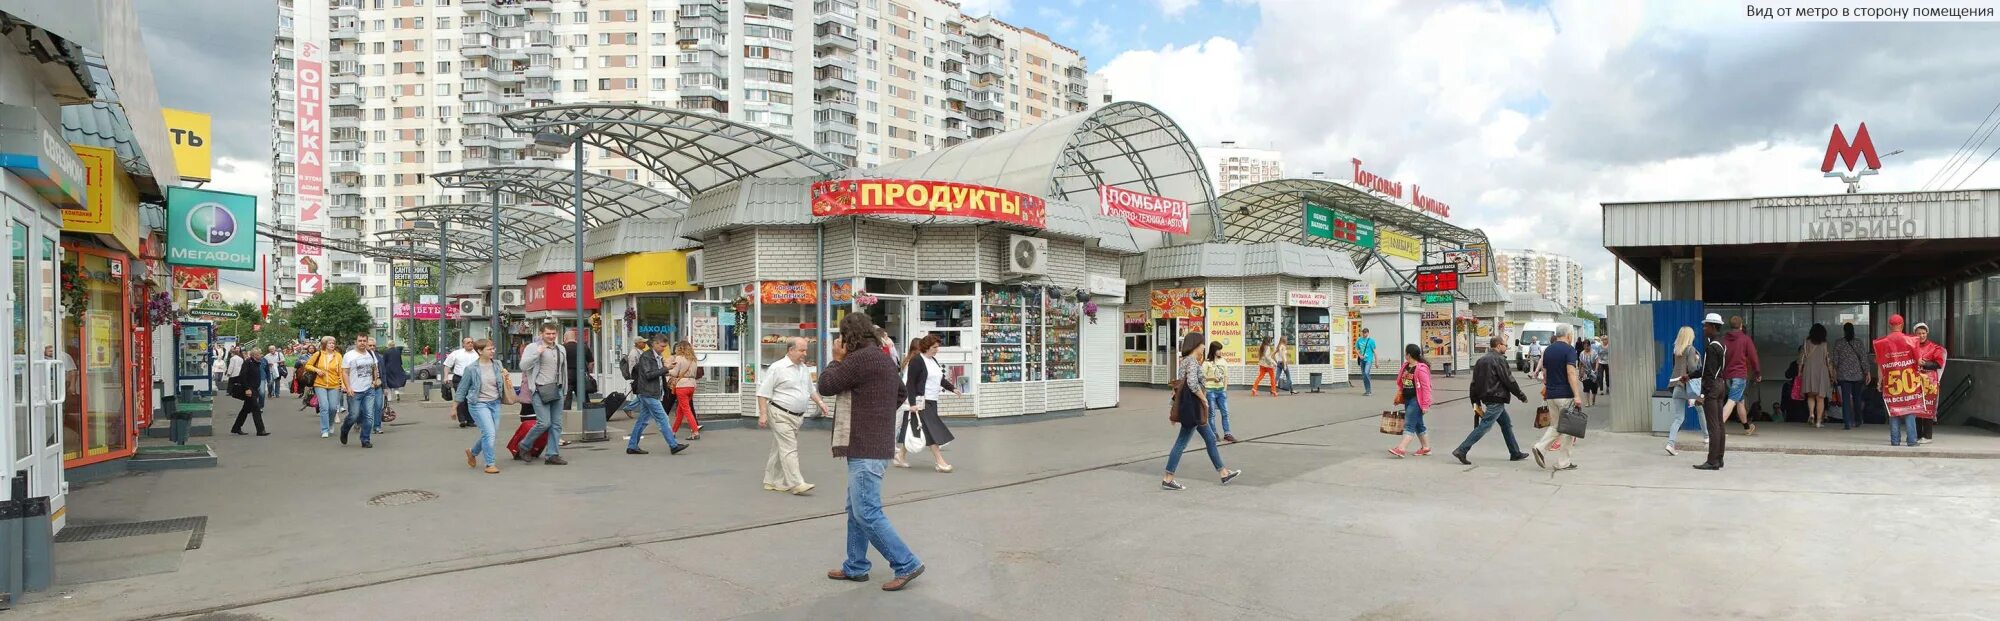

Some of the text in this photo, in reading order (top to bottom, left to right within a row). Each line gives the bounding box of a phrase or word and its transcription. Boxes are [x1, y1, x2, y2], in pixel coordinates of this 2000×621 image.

[299, 68, 321, 168] ОПТИКА
[861, 182, 1021, 216] ПРОДУКТЫ
[1108, 188, 1181, 218] ЛОМБАРД
[1823, 206, 1899, 218] СТАНЦИЯ
[1808, 218, 1917, 240] МАРЬИНО
[171, 247, 251, 264] МЕГАФОН
